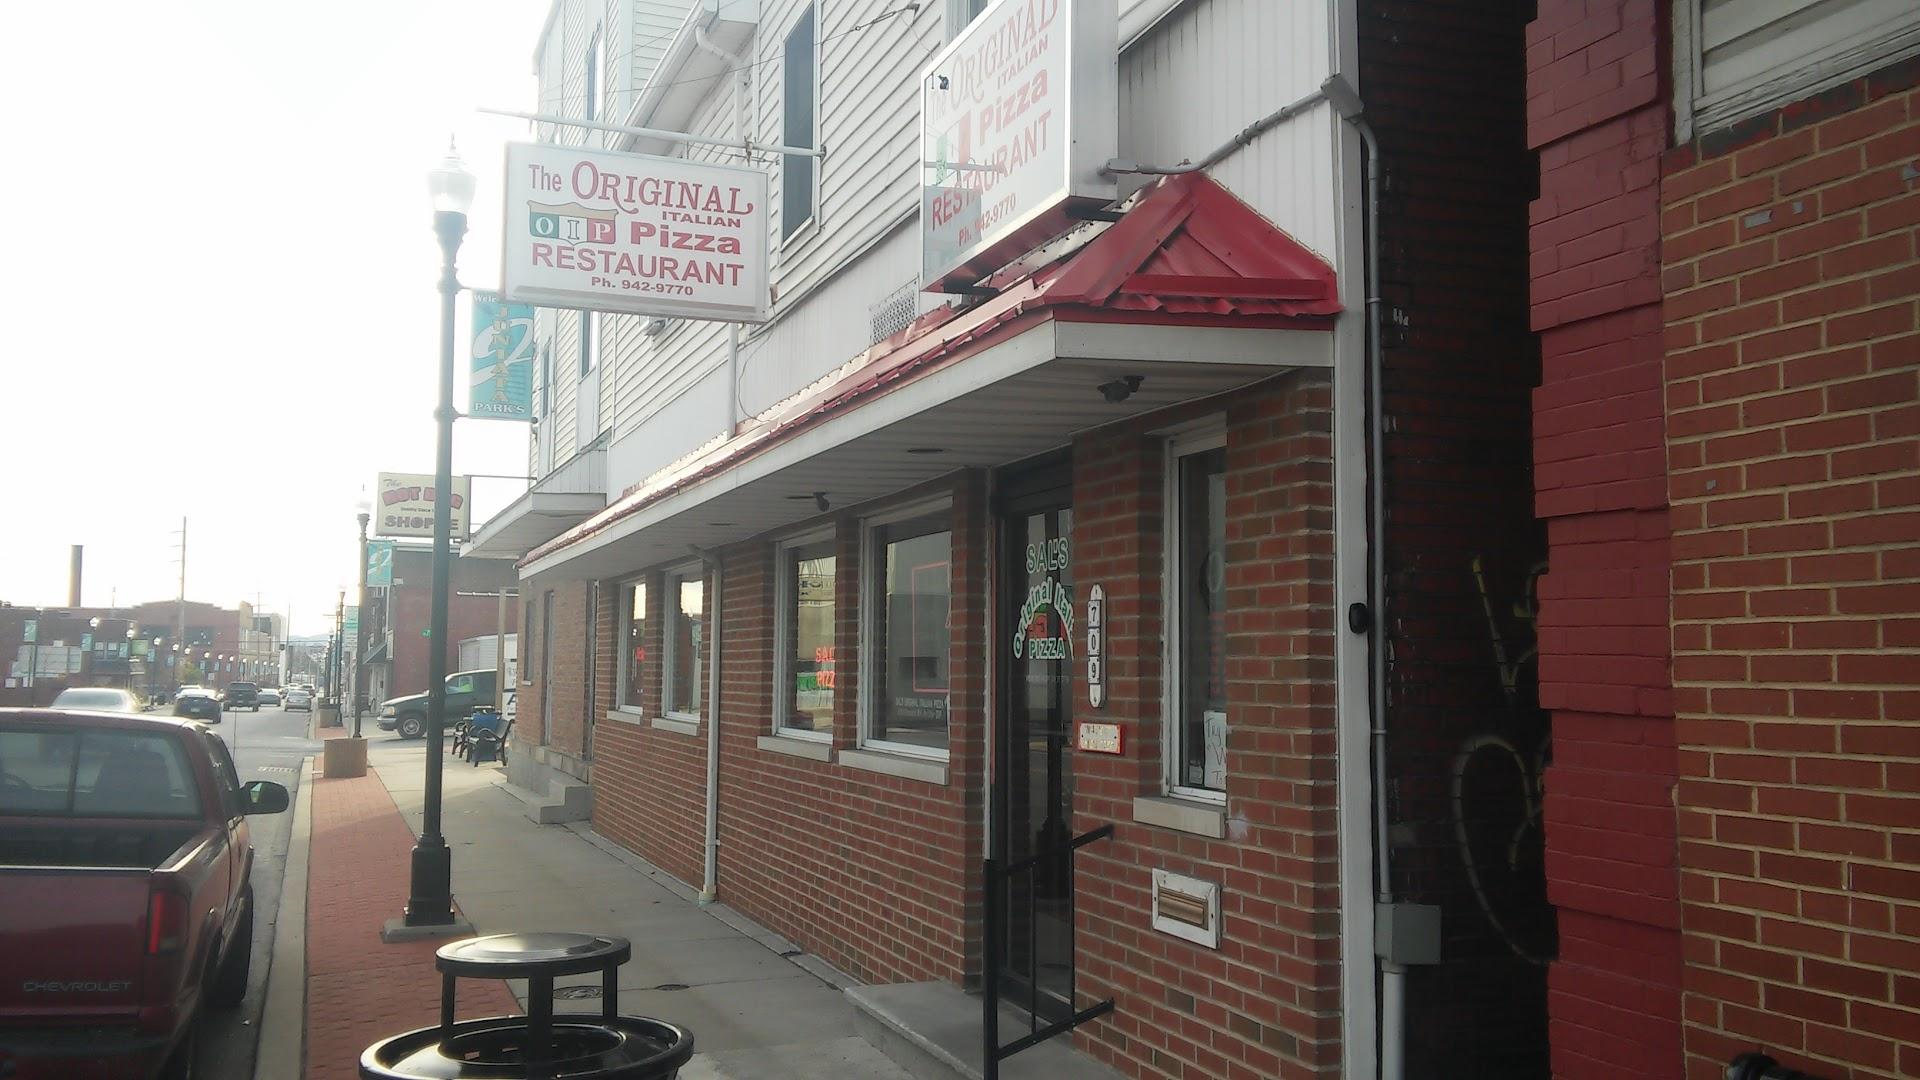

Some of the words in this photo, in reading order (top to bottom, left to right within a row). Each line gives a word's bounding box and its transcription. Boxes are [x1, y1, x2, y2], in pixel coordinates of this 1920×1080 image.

[997, 34, 1048, 90] ITALIAN
[979, 69, 1048, 146] Pizza
[528, 164, 562, 192] The
[571, 160, 754, 215] ORIGINAL
[932, 109, 1052, 232] RESTAURANT
[662, 210, 741, 228] ITALIAN
[630, 220, 741, 254] Pizza
[958, 227, 972, 247] Ph.
[532, 243, 744, 286] RESTAURANT
[591, 276, 616, 288] Ph.
[621, 280, 694, 296] 942-9770
[475, 402, 526, 414] PARK'S
[385, 514, 459, 530] SHOPE
[1026, 537, 1068, 573] SAL'S
[1014, 576, 1053, 659] Original
[1054, 582, 1075, 638] Itali
[1028, 638, 1066, 659] PIZZA
[23, 981, 132, 992] CHEVROLET
